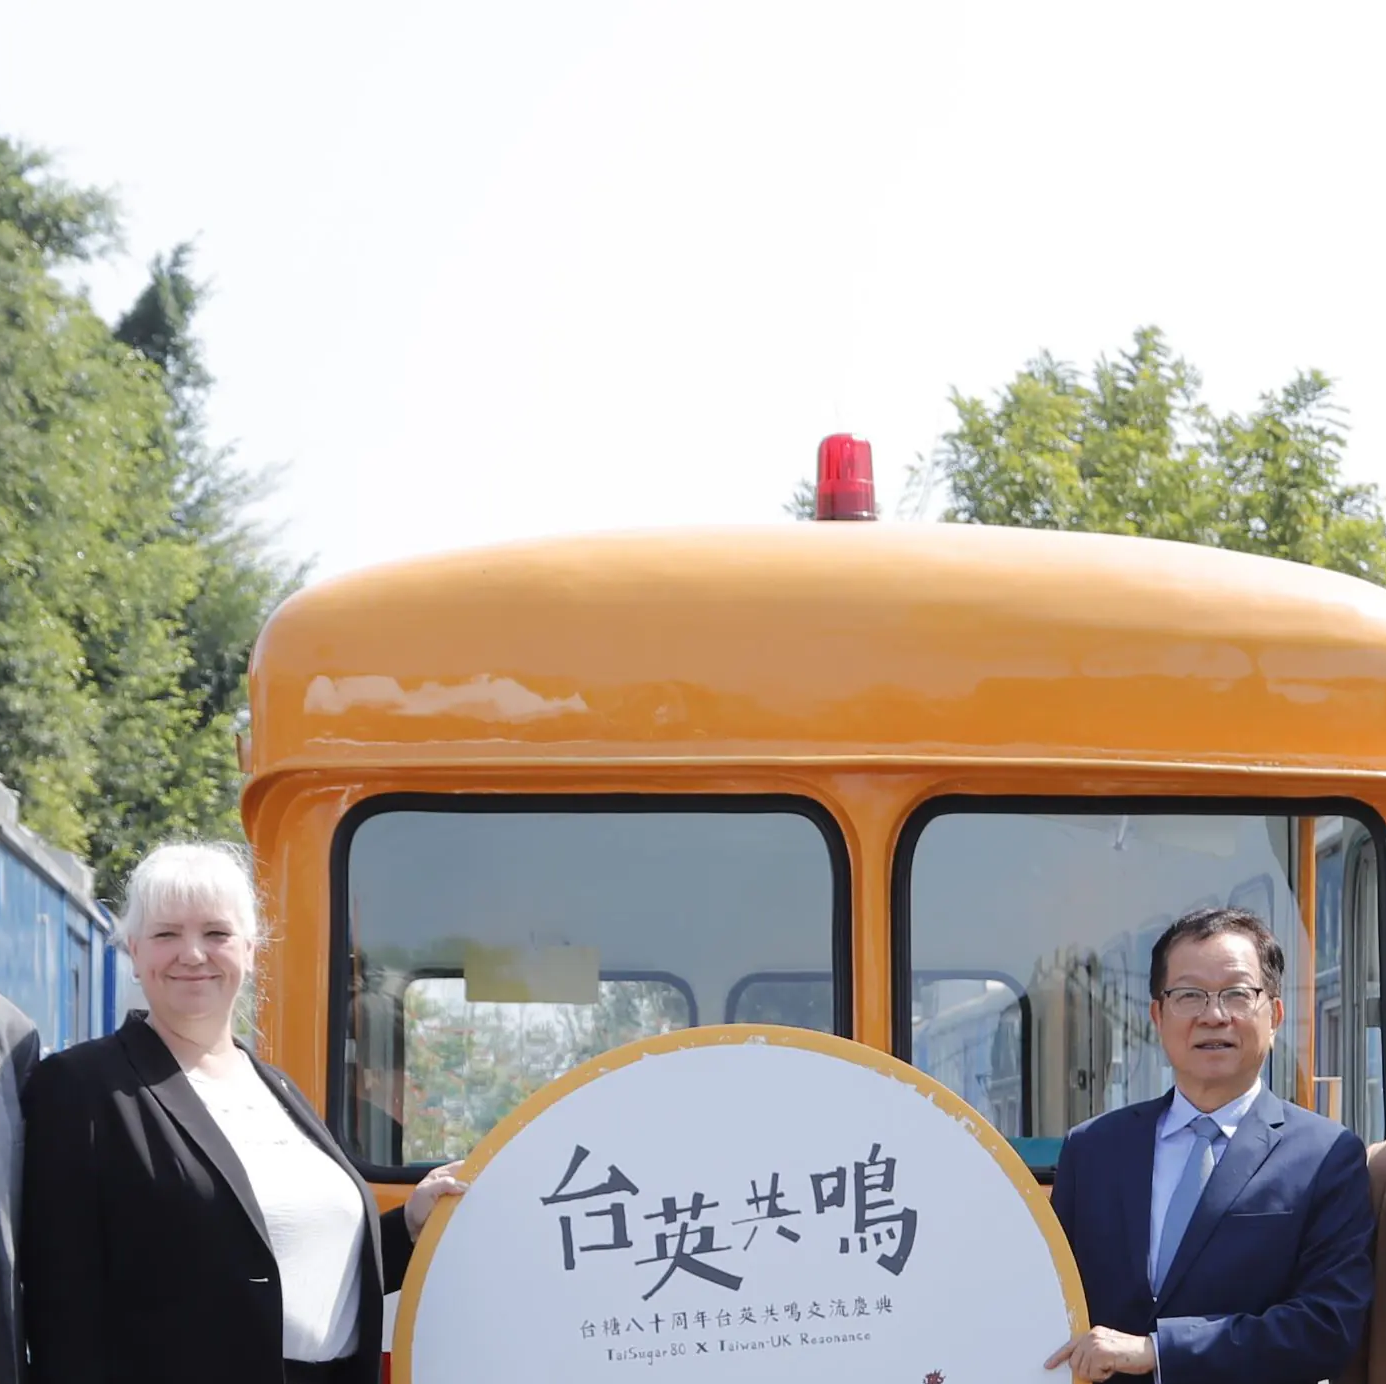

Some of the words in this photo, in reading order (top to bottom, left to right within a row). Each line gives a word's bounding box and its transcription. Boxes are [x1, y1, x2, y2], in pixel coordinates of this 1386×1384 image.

[540, 1143, 918, 1301] 台英共鳴
[800, 1331, 871, 1346] Resonance
